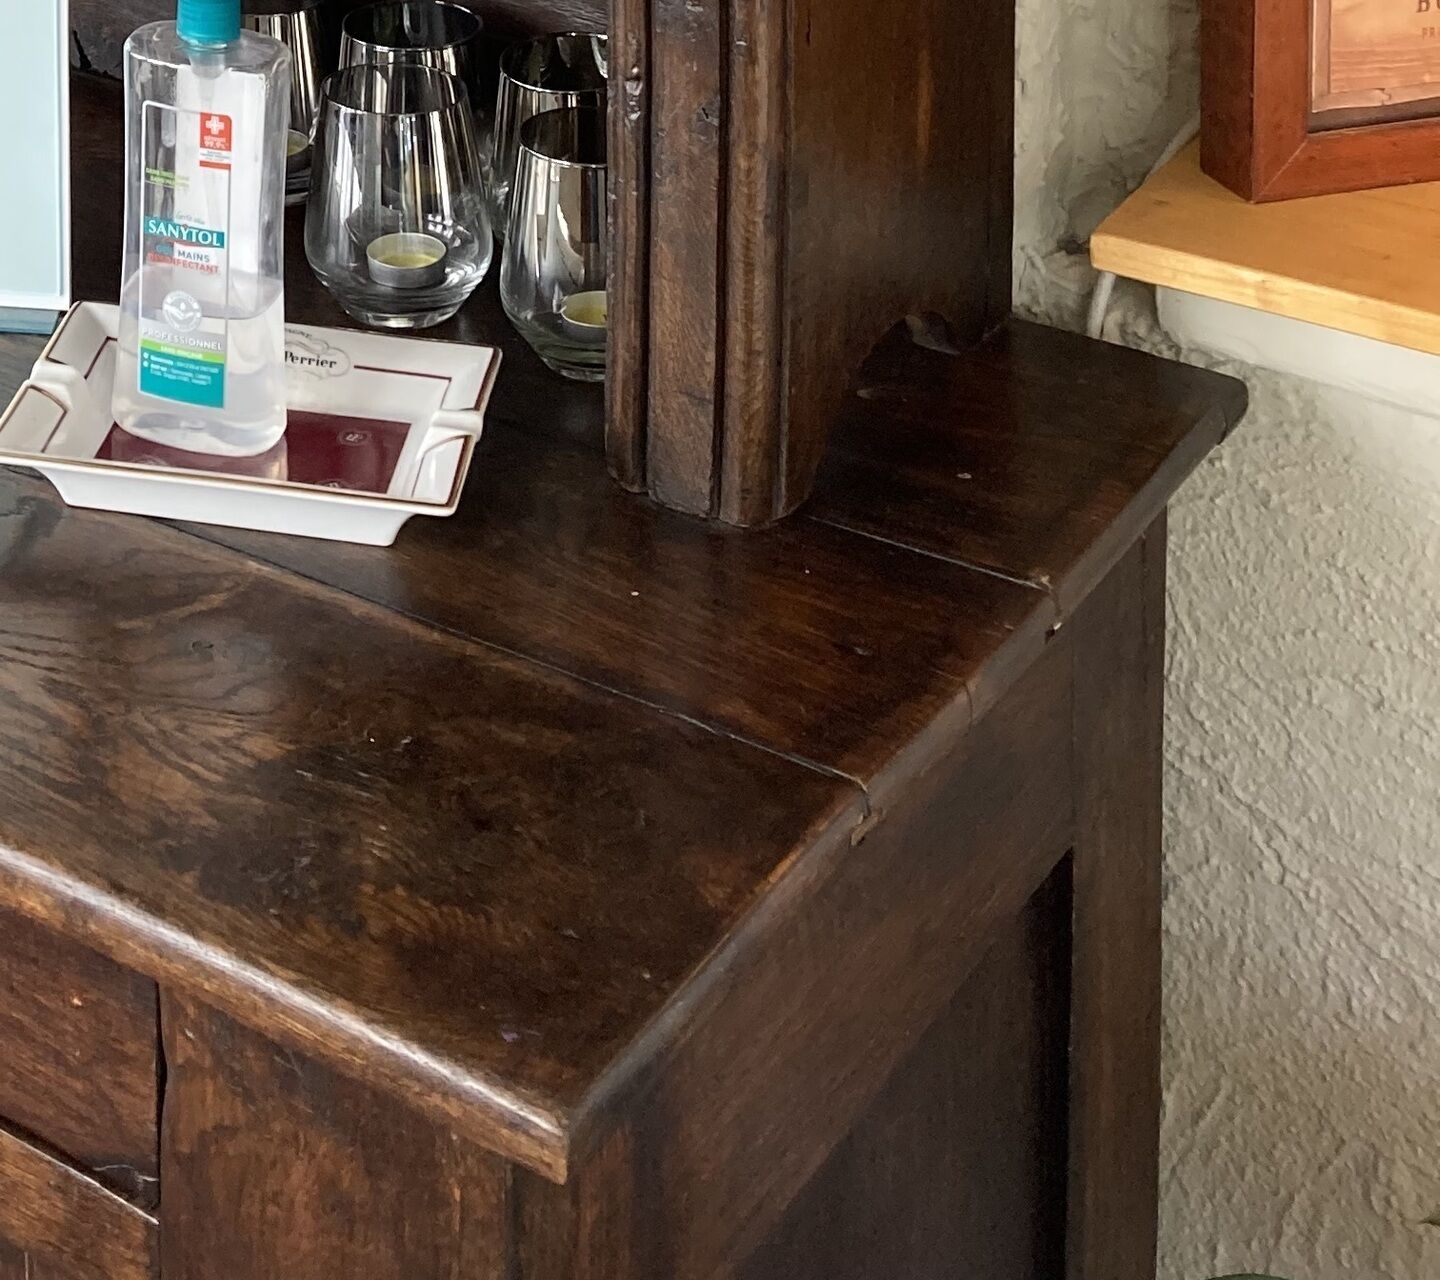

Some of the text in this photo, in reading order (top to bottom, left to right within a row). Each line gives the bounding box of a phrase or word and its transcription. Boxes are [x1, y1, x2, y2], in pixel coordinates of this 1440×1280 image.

[148, 219, 221, 247] SANYTOL
[177, 249, 211, 263] MAINS
[141, 327, 223, 351] PROFESSIONNEL
